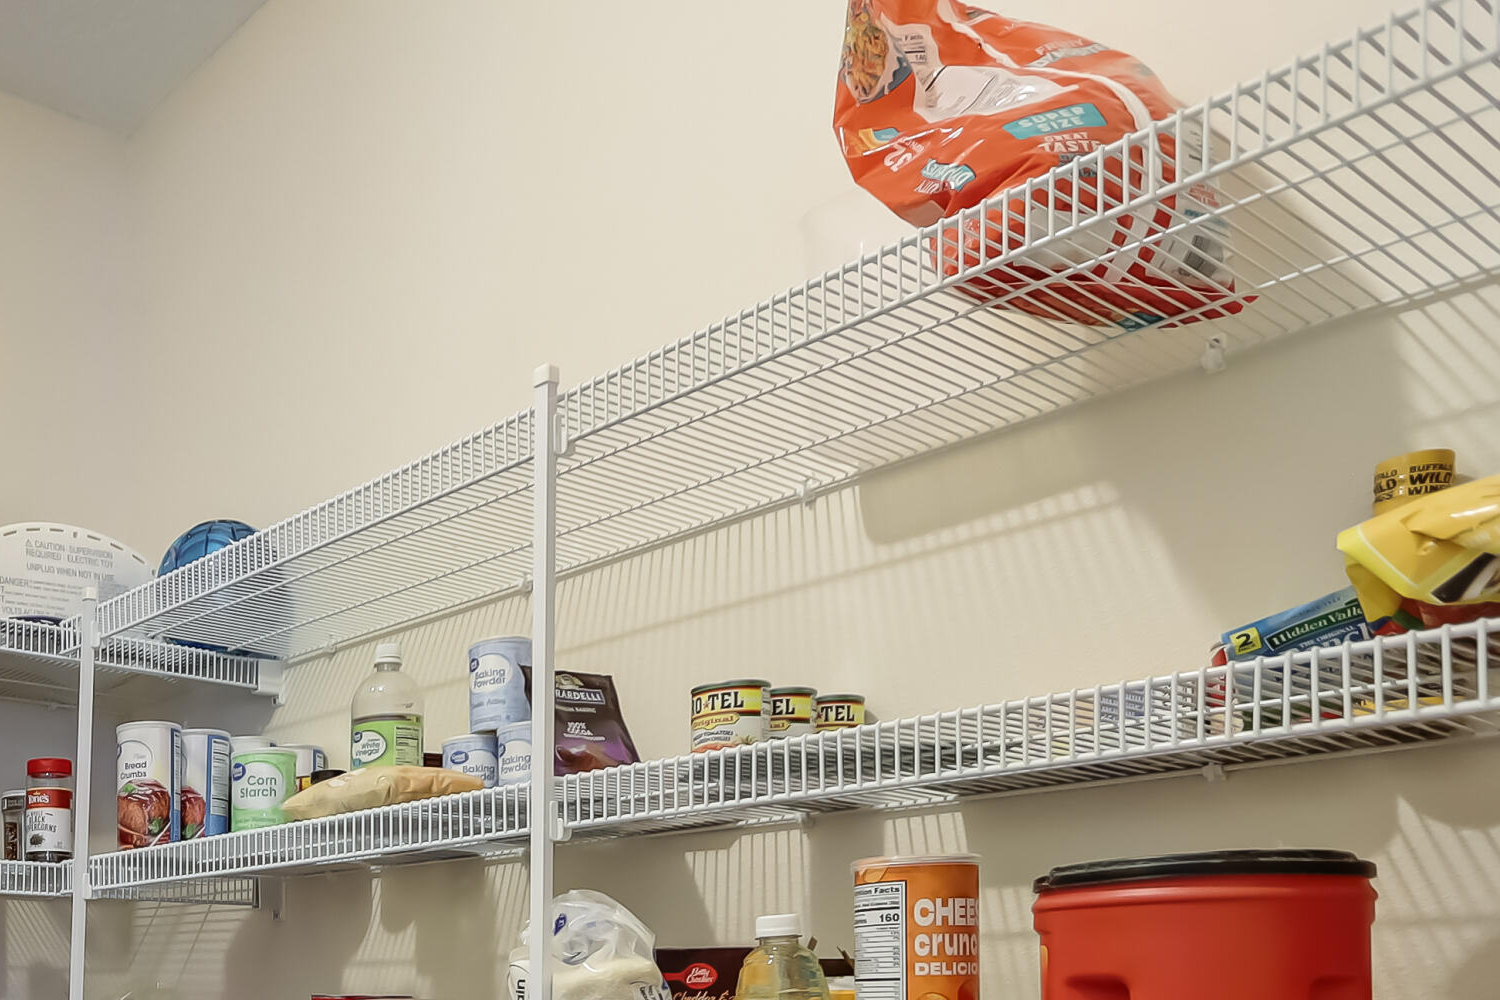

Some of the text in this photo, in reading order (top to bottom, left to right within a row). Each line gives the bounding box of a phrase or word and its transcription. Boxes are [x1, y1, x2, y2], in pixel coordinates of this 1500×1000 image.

[1018, 105, 1085, 128] SUPER
[1037, 116, 1085, 132] SIZE
[26, 547, 61, 561] REQUIRED
[67, 554, 99, 567] ELECTRIC
[35, 540, 113, 559] CAUTION SUPERVISION
[26, 562, 55, 573] UNPLUG
[56, 566, 77, 576] WHEN
[78, 570, 92, 579] NOT
[1272, 616, 1328, 647] Hidden
[1235, 632, 1253, 649] 2
[708, 691, 745, 711] TEL
[821, 704, 855, 722] TEL
[124, 760, 147, 770] Bread
[462, 765, 495, 775] Baking
[120, 770, 147, 779] Crumbs
[247, 775, 277, 786] Corn
[239, 786, 277, 798] Starch
[874, 887, 900, 895] Facts
[879, 913, 900, 923] 160
